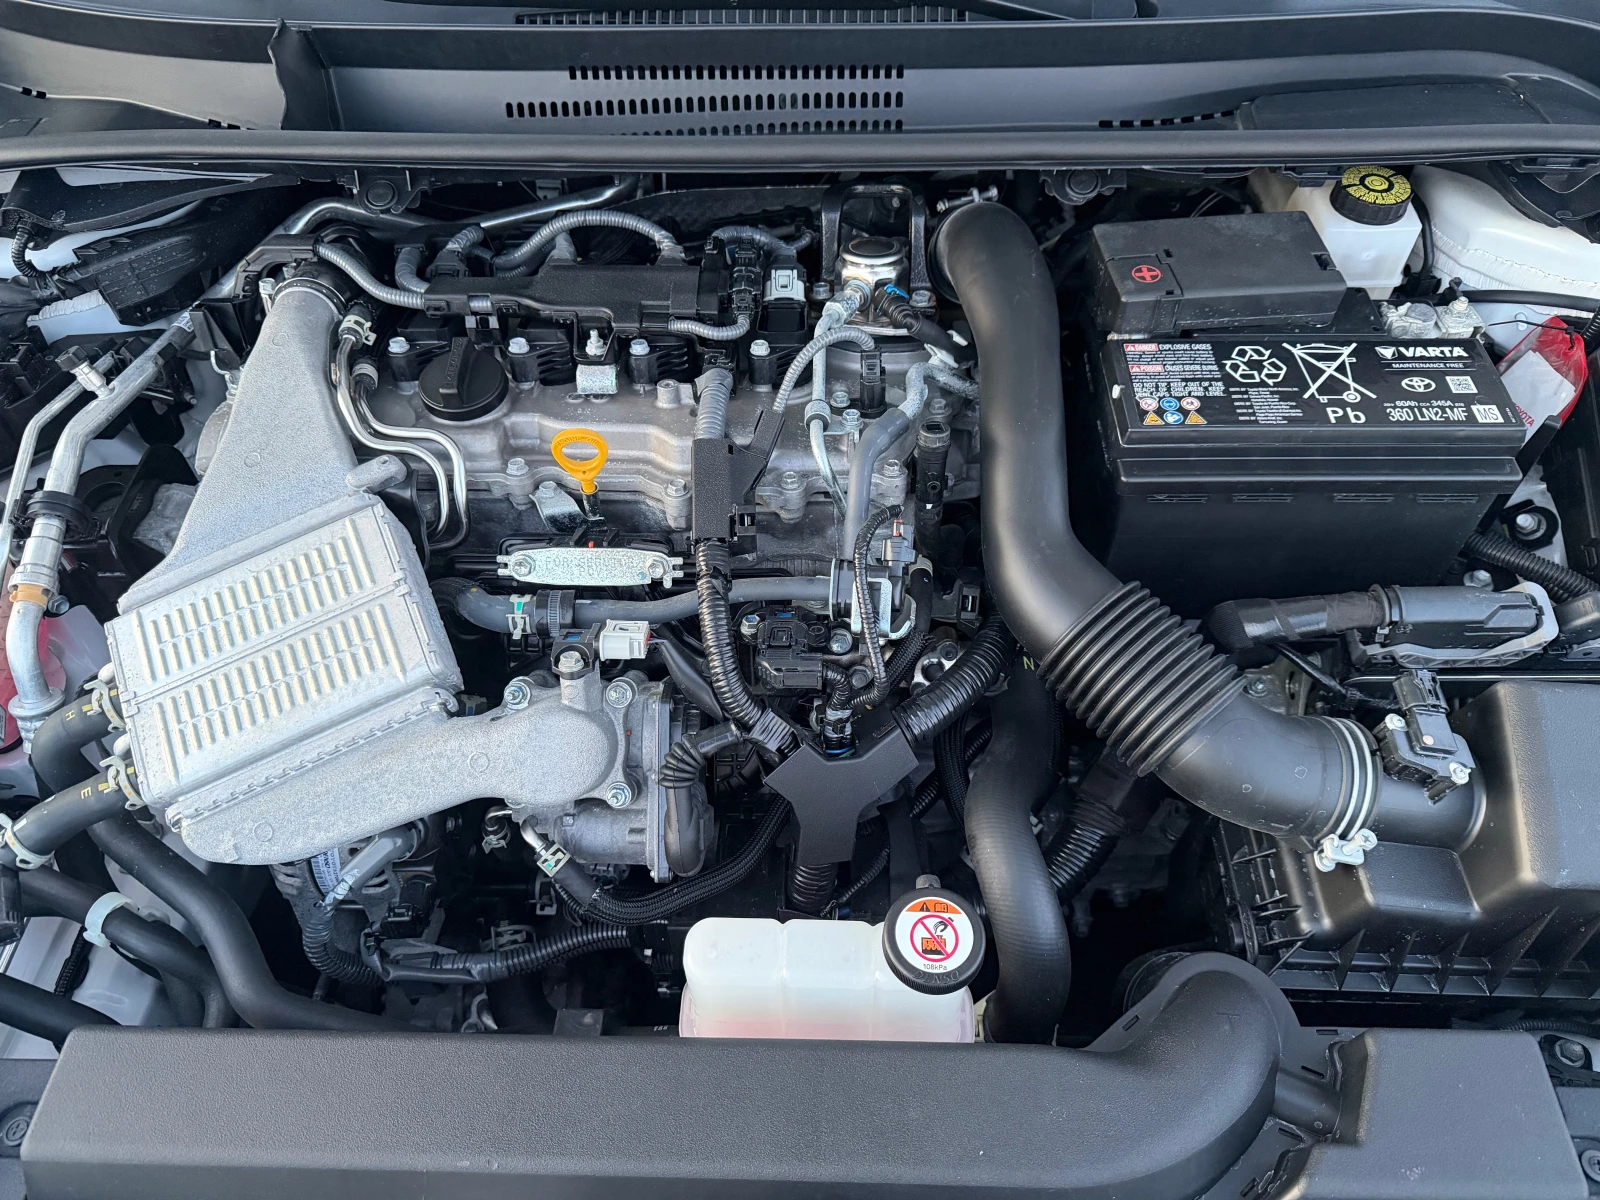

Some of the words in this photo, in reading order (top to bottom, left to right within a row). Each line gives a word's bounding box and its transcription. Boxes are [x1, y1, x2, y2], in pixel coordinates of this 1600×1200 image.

[1398, 346, 1469, 358] VARTA
[1326, 407, 1366, 424] Pb
[1386, 408, 1414, 421] 360
[1414, 408, 1468, 421] LN2-MF
[1477, 408, 1499, 418] MS
